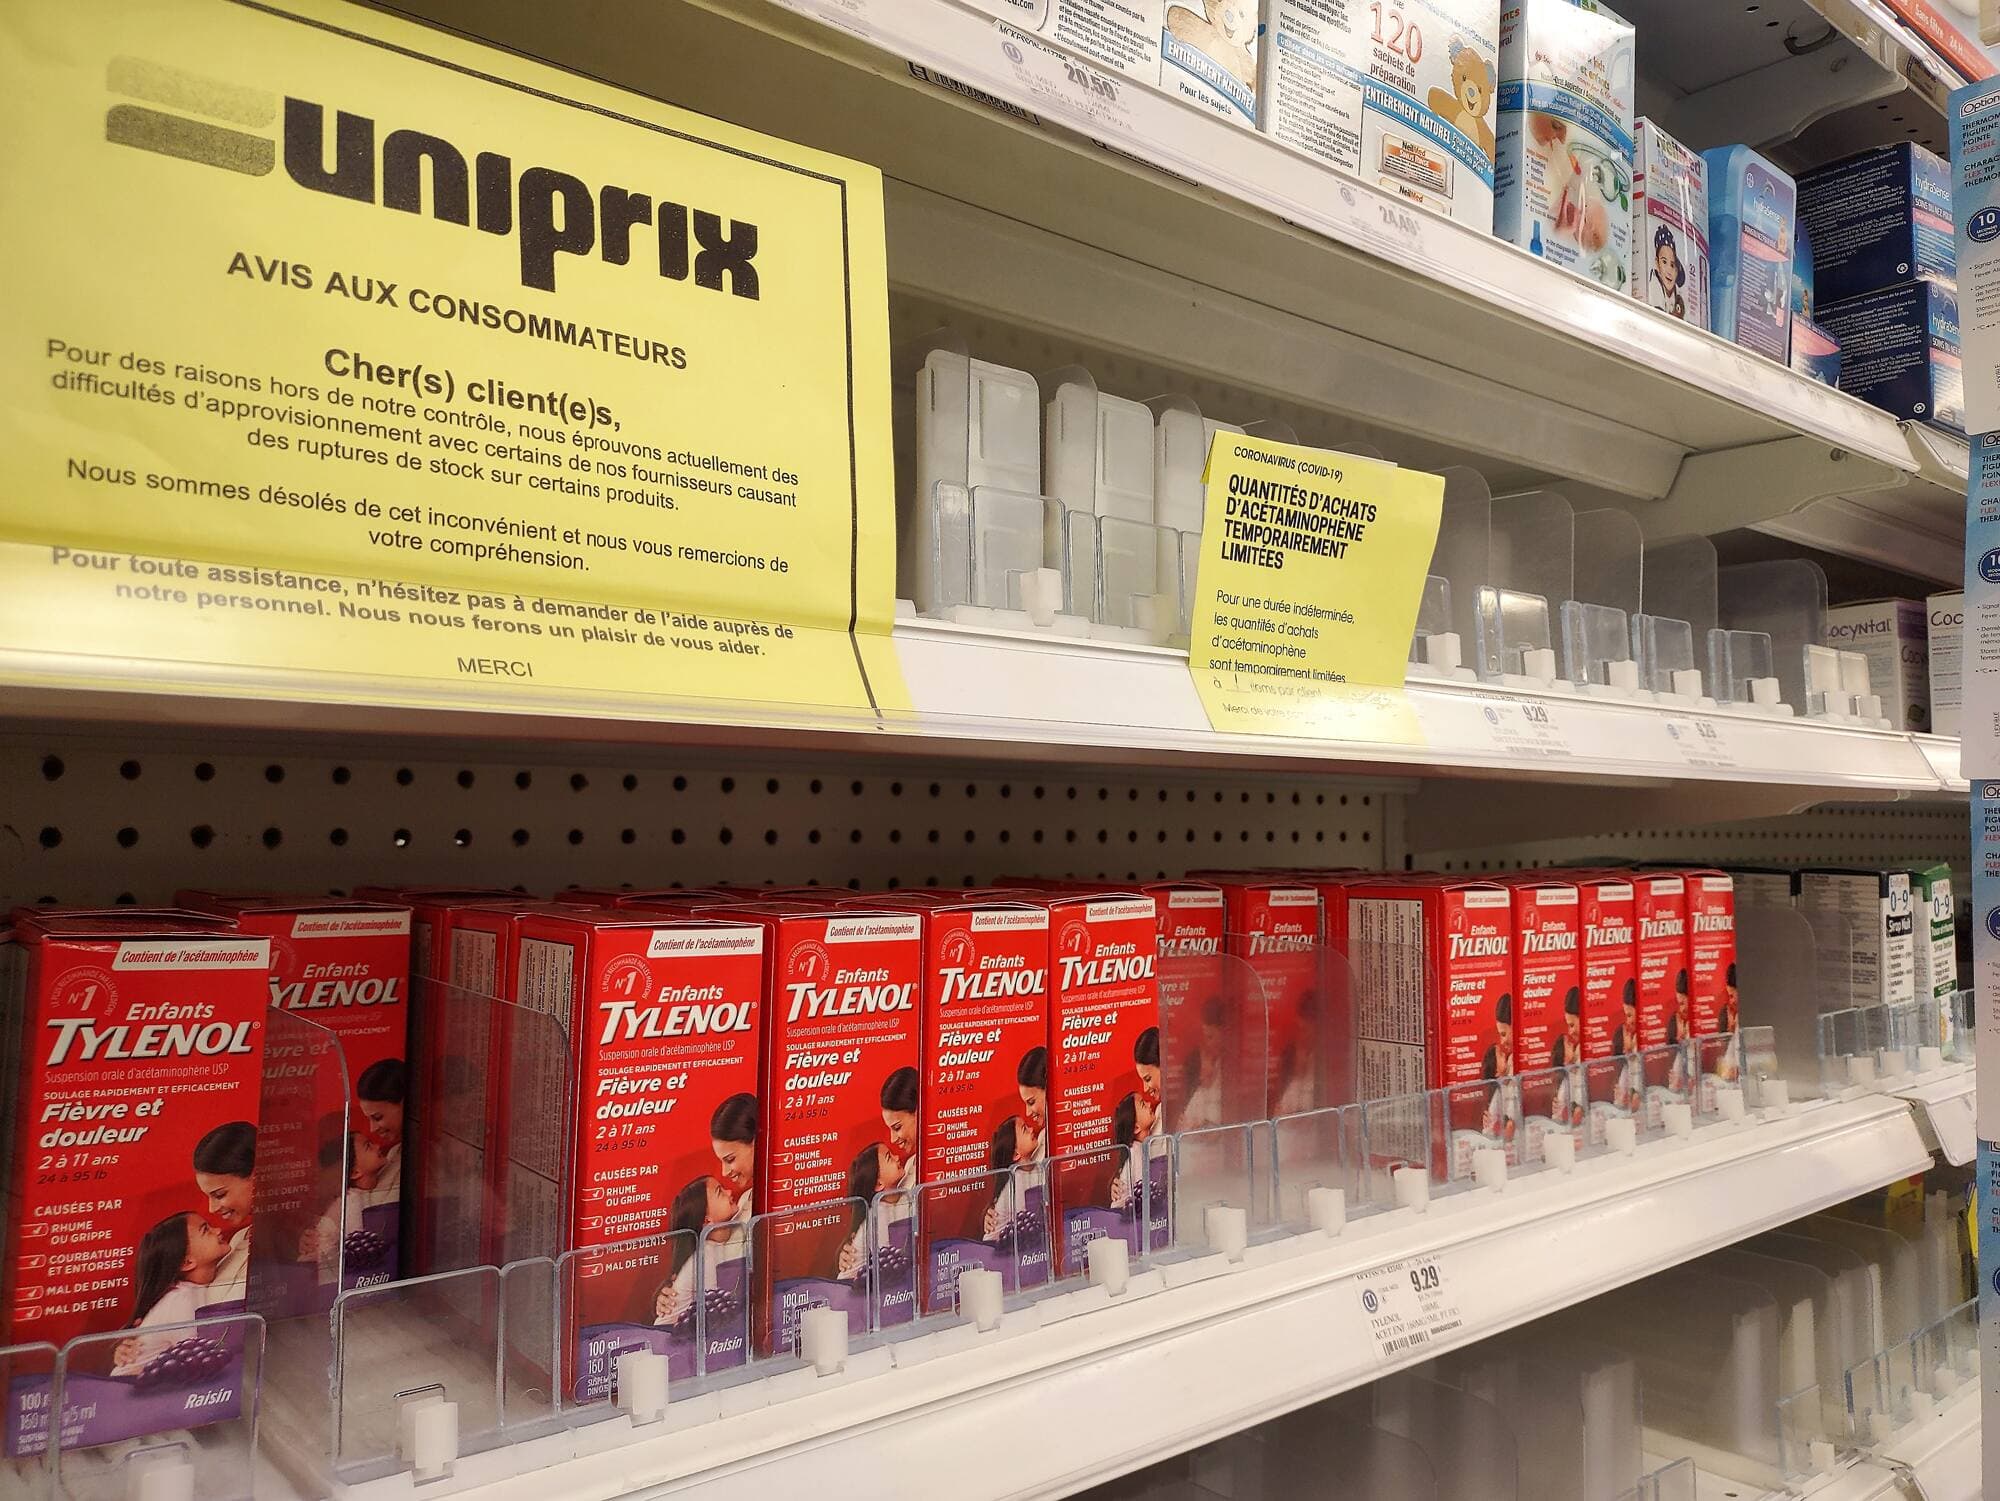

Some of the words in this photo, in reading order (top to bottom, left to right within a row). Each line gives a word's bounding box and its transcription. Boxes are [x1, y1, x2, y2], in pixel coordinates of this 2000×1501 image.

[1370, 1, 1423, 64] 120
[1373, 47, 1404, 71] sachets
[1405, 63, 1415, 77] de
[1370, 63, 1416, 95] préparation
[1198, 89, 1209, 104] les
[1210, 97, 1232, 115] sujets
[1221, 77, 1254, 113] NATUREL
[1366, 84, 1419, 123] ENTIÈREMENT
[1419, 112, 1450, 144] NATUREL
[1963, 132, 1991, 147] POINTE
[284, 96, 760, 300] uniprix
[1915, 172, 1950, 201] hydraSense
[1978, 212, 1995, 227] 10
[227, 252, 313, 289] AVIS
[325, 272, 399, 307] AUX
[408, 288, 687, 369] CONSOMMATEURS
[325, 348, 455, 403] Cher(s)
[467, 379, 621, 431] client(e)s,
[47, 339, 112, 367] Pour
[120, 352, 165, 376] des
[175, 362, 262, 392] raisons
[271, 377, 319, 401] hors
[327, 388, 354, 408] de
[362, 395, 416, 418] notre
[424, 406, 511, 437] contrôle,
[519, 422, 565, 444] nous
[572, 430, 661, 461] éprouvons
[667, 449, 768, 480] actuellement
[772, 468, 799, 486] des
[52, 370, 175, 405] difficultés
[429, 433, 478, 454] avec
[485, 442, 562, 467] certains
[568, 453, 591, 472] de
[597, 462, 626, 478] nos
[632, 464, 732, 496] fournisseurs
[737, 485, 797, 507] causant
[248, 428, 289, 450] des
[298, 437, 388, 466] ruptures
[396, 451, 422, 470] de
[430, 458, 484, 480] stock
[491, 467, 523, 485] sur
[528, 472, 600, 498] certains
[607, 487, 679, 510] produits.
[1234, 446, 1296, 470] CORONAVIRUS
[1297, 460, 1343, 482] (COVID-19)
[1229, 474, 1307, 508] QUANTITÉS
[67, 458, 136, 485] Nous
[146, 473, 250, 500] sommes
[259, 485, 347, 513] désolés
[354, 499, 381, 518] de
[389, 505, 421, 523] cet
[428, 508, 557, 541] inconvénient
[563, 529, 580, 544] et
[586, 532, 627, 551] nous
[632, 538, 673, 557] vous
[678, 544, 765, 571] remercions
[769, 556, 788, 573] de
[368, 530, 422, 550] votre
[430, 537, 590, 571] compréhension.
[1224, 518, 1348, 560] TEMPORAIREMENT
[1221, 541, 1284, 569] LIMITÉES
[52, 545, 120, 571] Pour
[129, 554, 199, 578] toute
[207, 565, 348, 596] assistance,
[467, 592, 505, 611] pas
[513, 595, 524, 611] à
[532, 597, 628, 623] demander
[634, 608, 655, 625] de
[713, 618, 770, 639] auprès
[774, 624, 794, 639] de
[116, 581, 187, 604] notre
[198, 589, 331, 616] personnel.
[339, 601, 401, 622] Nous
[409, 611, 465, 628] nous
[471, 615, 542, 636] ferons
[549, 624, 574, 639] un
[581, 626, 637, 645] plaisir
[643, 632, 665, 648] de
[671, 636, 713, 651] vous
[719, 639, 765, 656] aider.
[1216, 589, 1240, 605] Pour
[1242, 597, 1261, 609] une
[1263, 597, 1291, 613] durée
[1293, 601, 1355, 625] indéterminée,
[1214, 612, 1228, 626] les
[1230, 616, 1276, 633] quantités
[457, 657, 533, 677] MERCI
[1209, 659, 1232, 670] sont
[1234, 659, 1311, 681] temporairement
[1313, 668, 1346, 683] limitées
[1471, 925, 1497, 936] Enfants
[1639, 917, 1684, 940] TYLENOL
[1692, 911, 1733, 933] TYLENOL
[1249, 931, 1315, 956] TYLENOL
[1448, 933, 1508, 960] TYLENOL
[1522, 929, 1577, 954] TYLENOL
[1585, 924, 1633, 949] TYLENOL
[122, 949, 166, 964] Contient
[168, 949, 179, 962] de
[979, 954, 1025, 970] Enfants
[1095, 943, 1136, 958] Enfants
[302, 962, 370, 979] Enfants
[834, 969, 889, 984] Enfants
[1059, 955, 1155, 992] TYLENOL
[658, 985, 724, 1003] Enfants
[938, 967, 1044, 1005] TYLENOL
[125, 1002, 215, 1021] Enfants
[785, 982, 914, 1023] TYLENOL
[599, 1001, 752, 1046] TYLENOL
[45, 1017, 253, 1066] TYLENOL
[596, 1074, 661, 1096] Fièvre
[667, 1072, 688, 1089] et
[40, 1098, 129, 1124] Fièvre
[136, 1099, 163, 1118] et
[596, 1097, 677, 1121] douleur
[39, 1124, 149, 1149] douleur
[34, 1200, 95, 1218] CAUSÉES
[98, 1198, 122, 1211] PAR
[50, 1233, 68, 1245] OU
[70, 1230, 112, 1243] GRIPPE
[51, 1221, 93, 1233] RHUME
[356, 1271, 390, 1288] Raisin
[1410, 1265, 1440, 1293] 9.29
[184, 1388, 232, 1410] Raisin
